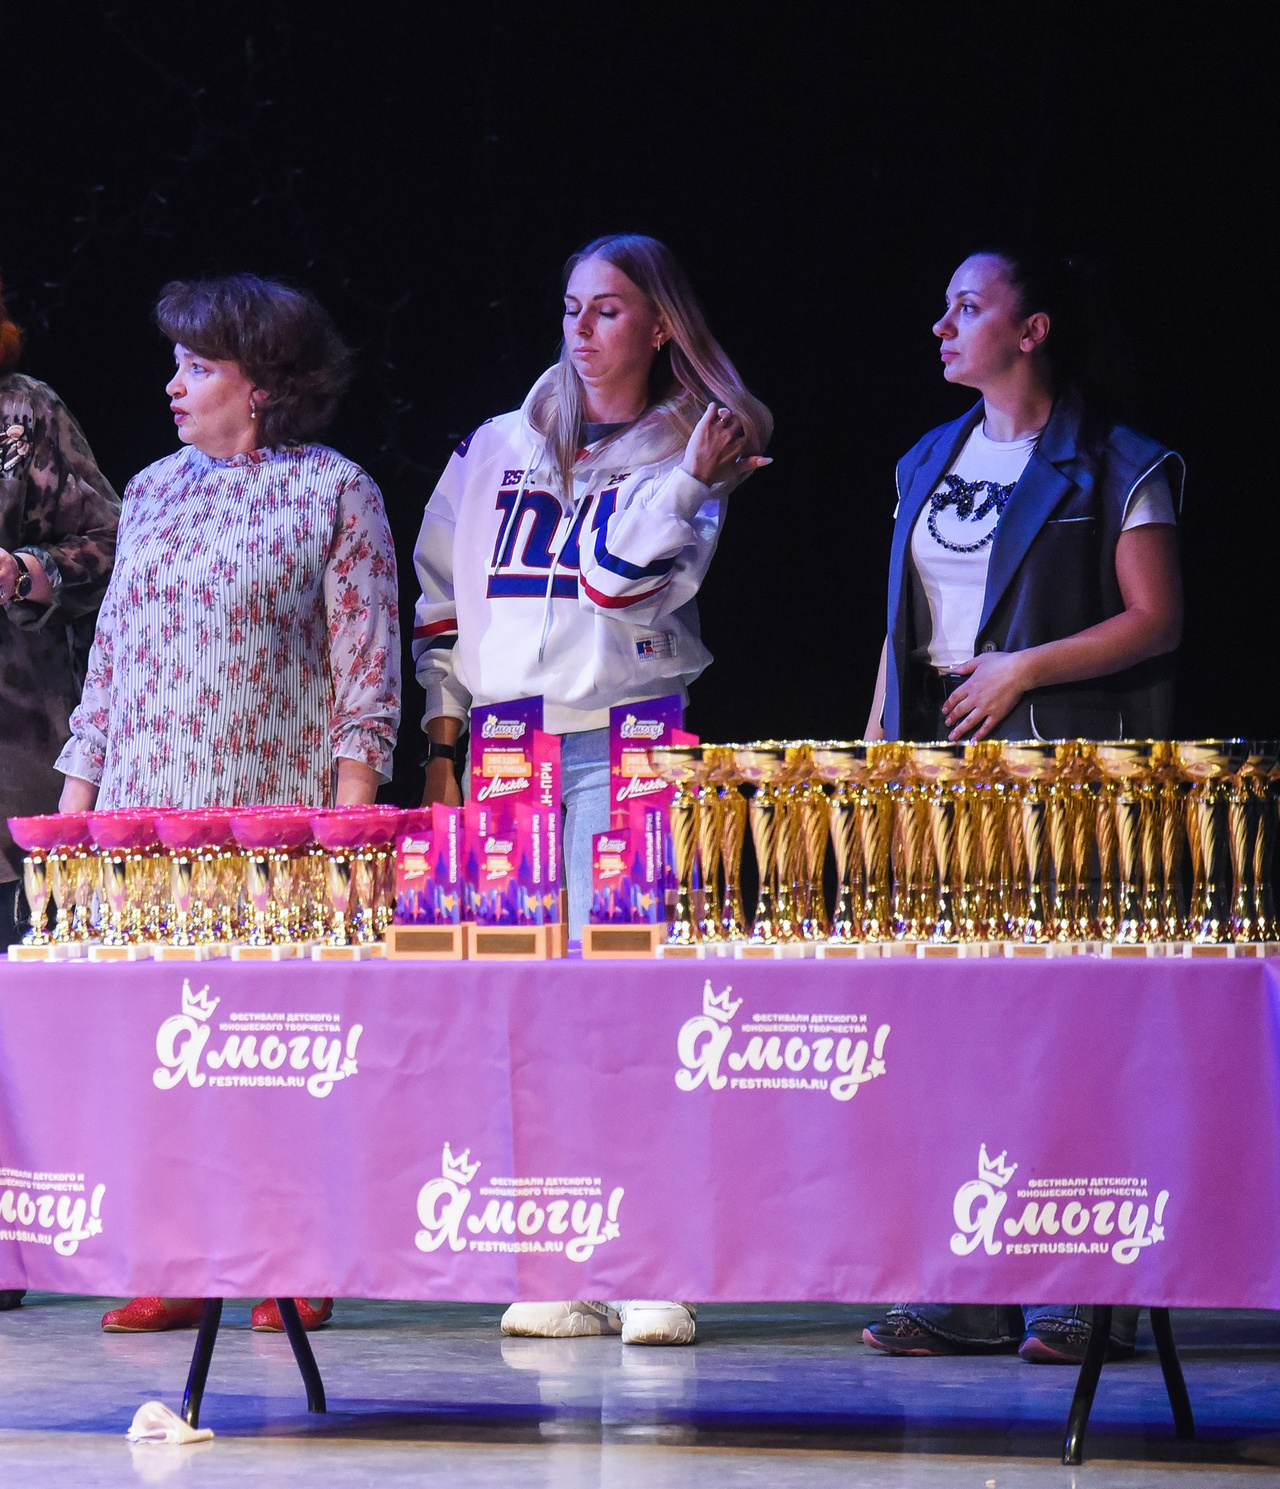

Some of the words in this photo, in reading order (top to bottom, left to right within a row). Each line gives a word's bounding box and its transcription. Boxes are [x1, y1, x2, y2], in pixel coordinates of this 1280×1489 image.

[501, 469, 535, 486] ES.
[478, 773, 530, 801] Москва
[541, 762, 553, 807] Н-ПРИ
[616, 774, 668, 801] Москва
[230, 1013, 285, 1022] ФЕСТИВАЛИ
[287, 1013, 331, 1023] ДЕТСКОГО
[333, 1014, 340, 1022] И
[752, 1013, 809, 1023] ФЕСТИВАЛИ
[811, 1014, 857, 1023] ДЕТСКОГО
[859, 1014, 867, 1023] И
[219, 1023, 283, 1032] ЮНОШЕСКОГО
[285, 1023, 340, 1032] ТВОРЧЕСТВА
[741, 1024, 807, 1032] ЮНОШЕСКОГО
[808, 1024, 867, 1033] ТВОРЧЕСТВА
[209, 1076, 306, 1087] FESTRUSSIA.RU
[730, 1078, 828, 1090] FESTRUSSIA.RU
[33, 1172, 76, 1182] ДЕТСКОГО
[78, 1173, 84, 1181] И
[490, 1177, 544, 1186] ФЕСТИВАЛИ
[545, 1177, 592, 1187] ДЕТСКОГО
[32, 1182, 85, 1192] ТВОРЧЕСТВА
[1028, 1178, 1088, 1188] ФЕСТИВАЛИ
[1090, 1177, 1139, 1187] ДЕТСКОГО
[1141, 1178, 1147, 1187] И
[480, 1187, 541, 1196] ЮНОШЕСКОГО
[543, 1187, 601, 1196] ТВОРЧЕСТВА
[1017, 1188, 1085, 1198] ЮНОШЕСКОГО
[1087, 1188, 1148, 1197] ТВОРЧЕСТВА
[470, 1241, 563, 1253] FESTRUSSIA.RU
[1006, 1242, 1109, 1255] FESTRUSSIA.RU
